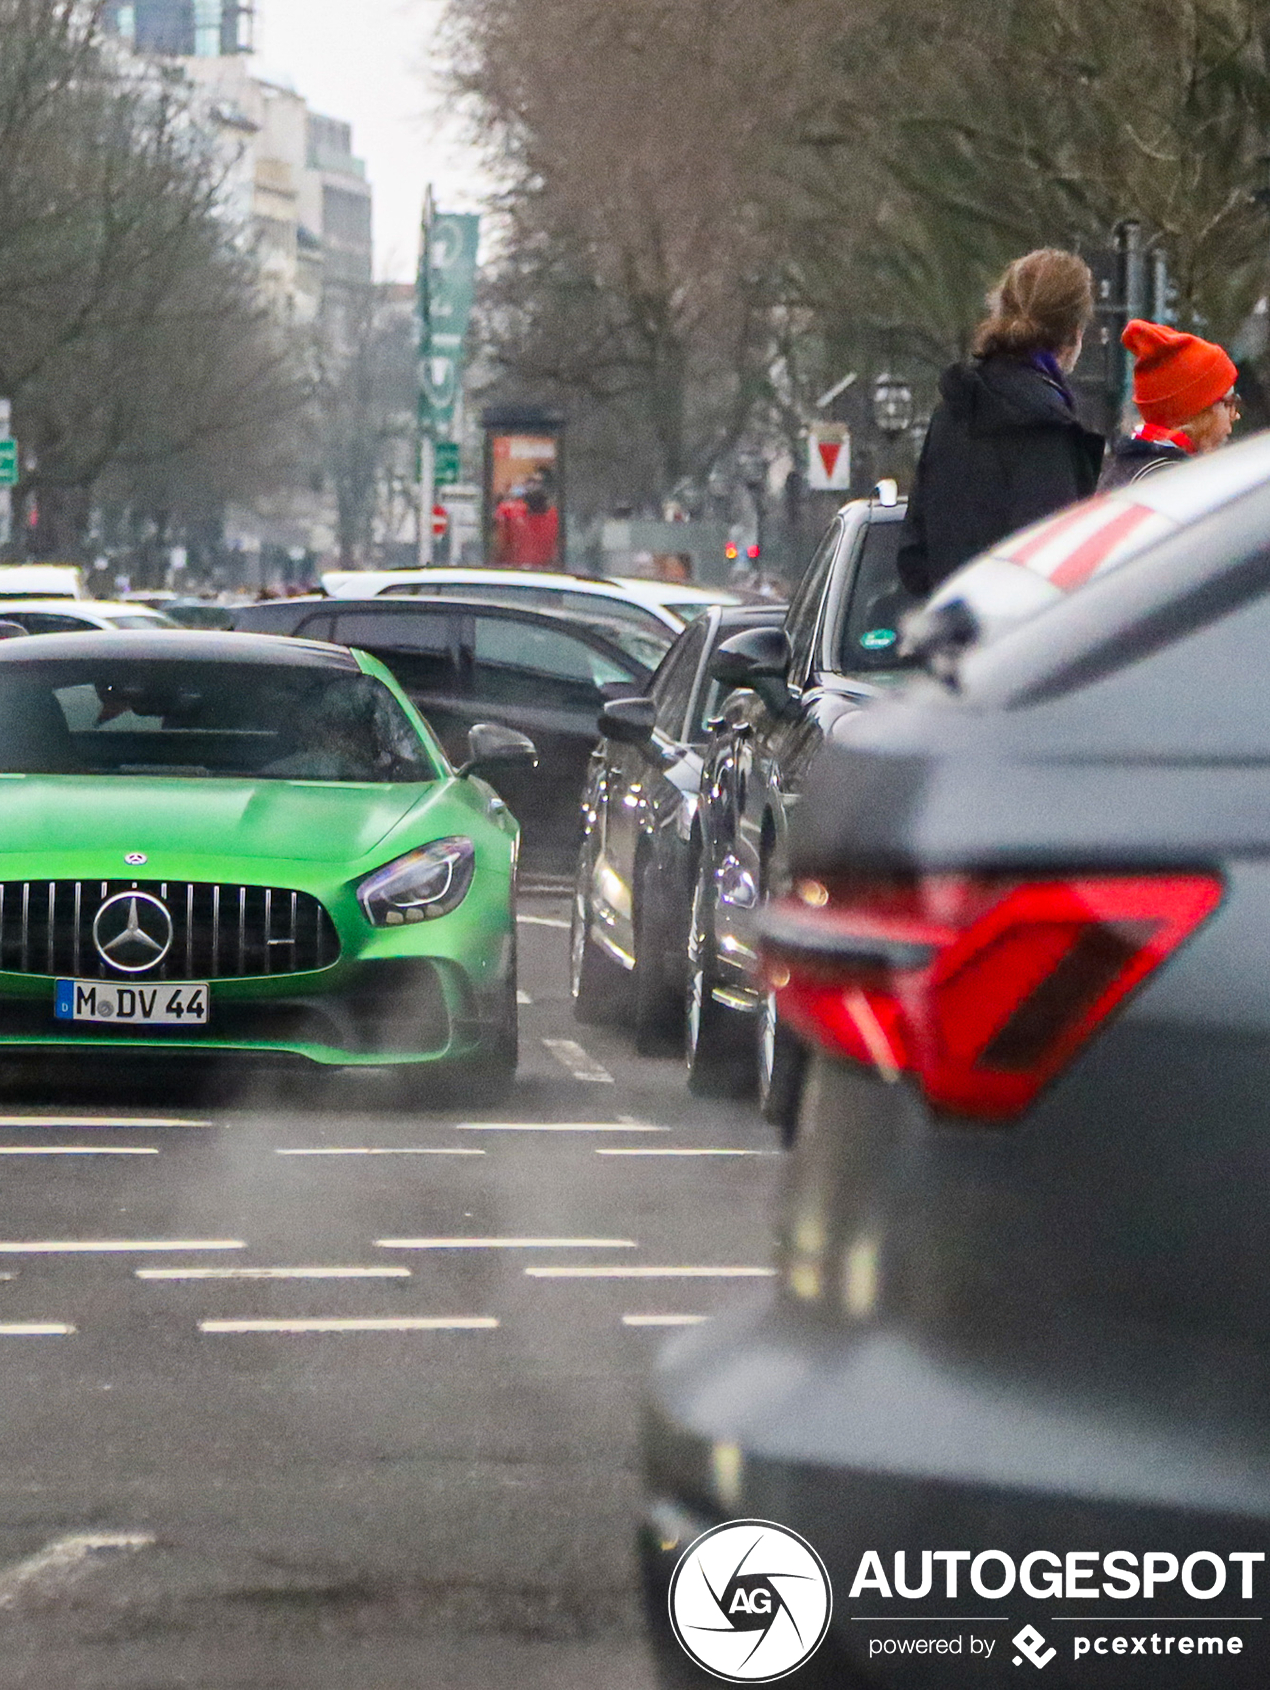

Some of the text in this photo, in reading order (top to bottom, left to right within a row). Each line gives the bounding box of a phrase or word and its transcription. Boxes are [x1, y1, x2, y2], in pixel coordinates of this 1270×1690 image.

[61, 986, 205, 1018] D M DV 44
